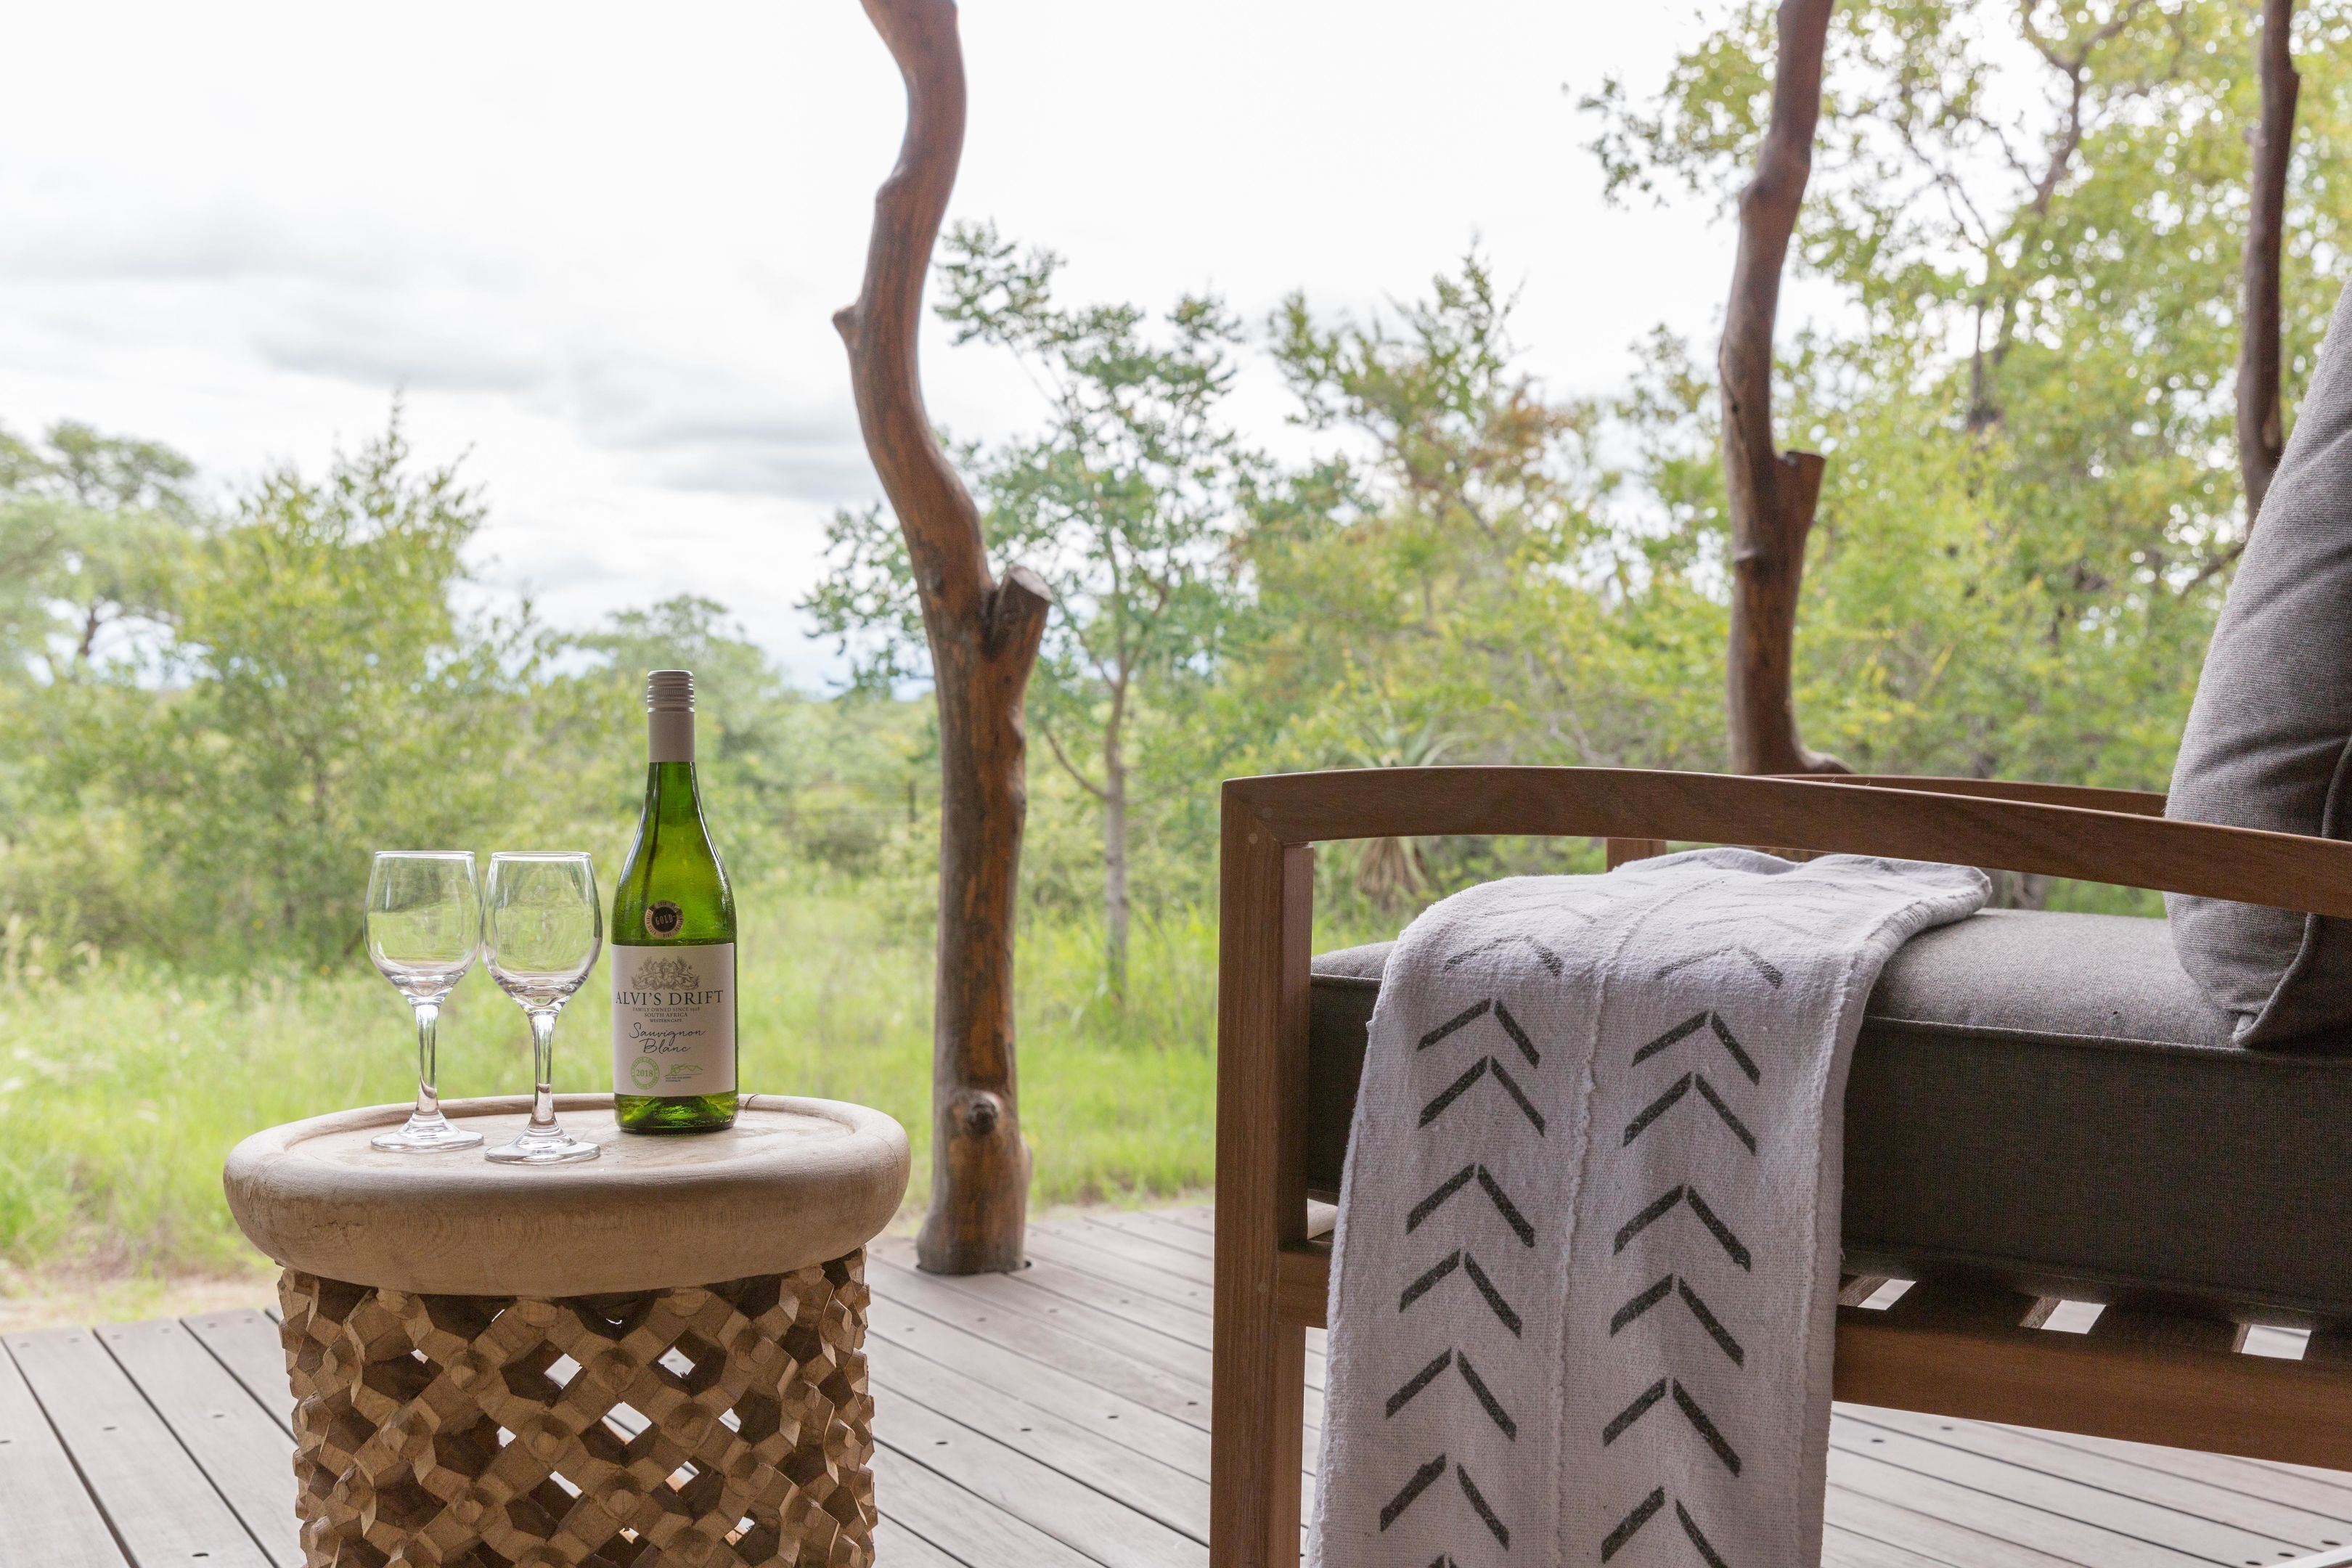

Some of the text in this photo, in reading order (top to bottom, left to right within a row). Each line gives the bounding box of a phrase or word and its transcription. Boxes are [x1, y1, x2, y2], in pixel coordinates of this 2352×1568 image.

[656, 914, 673, 926] GOLD
[616, 990, 723, 1005] ALVI'S DRIFT
[629, 1022, 706, 1046] Sauvignon
[639, 1038, 691, 1054] Blanc
[635, 1069, 654, 1077] 2018
